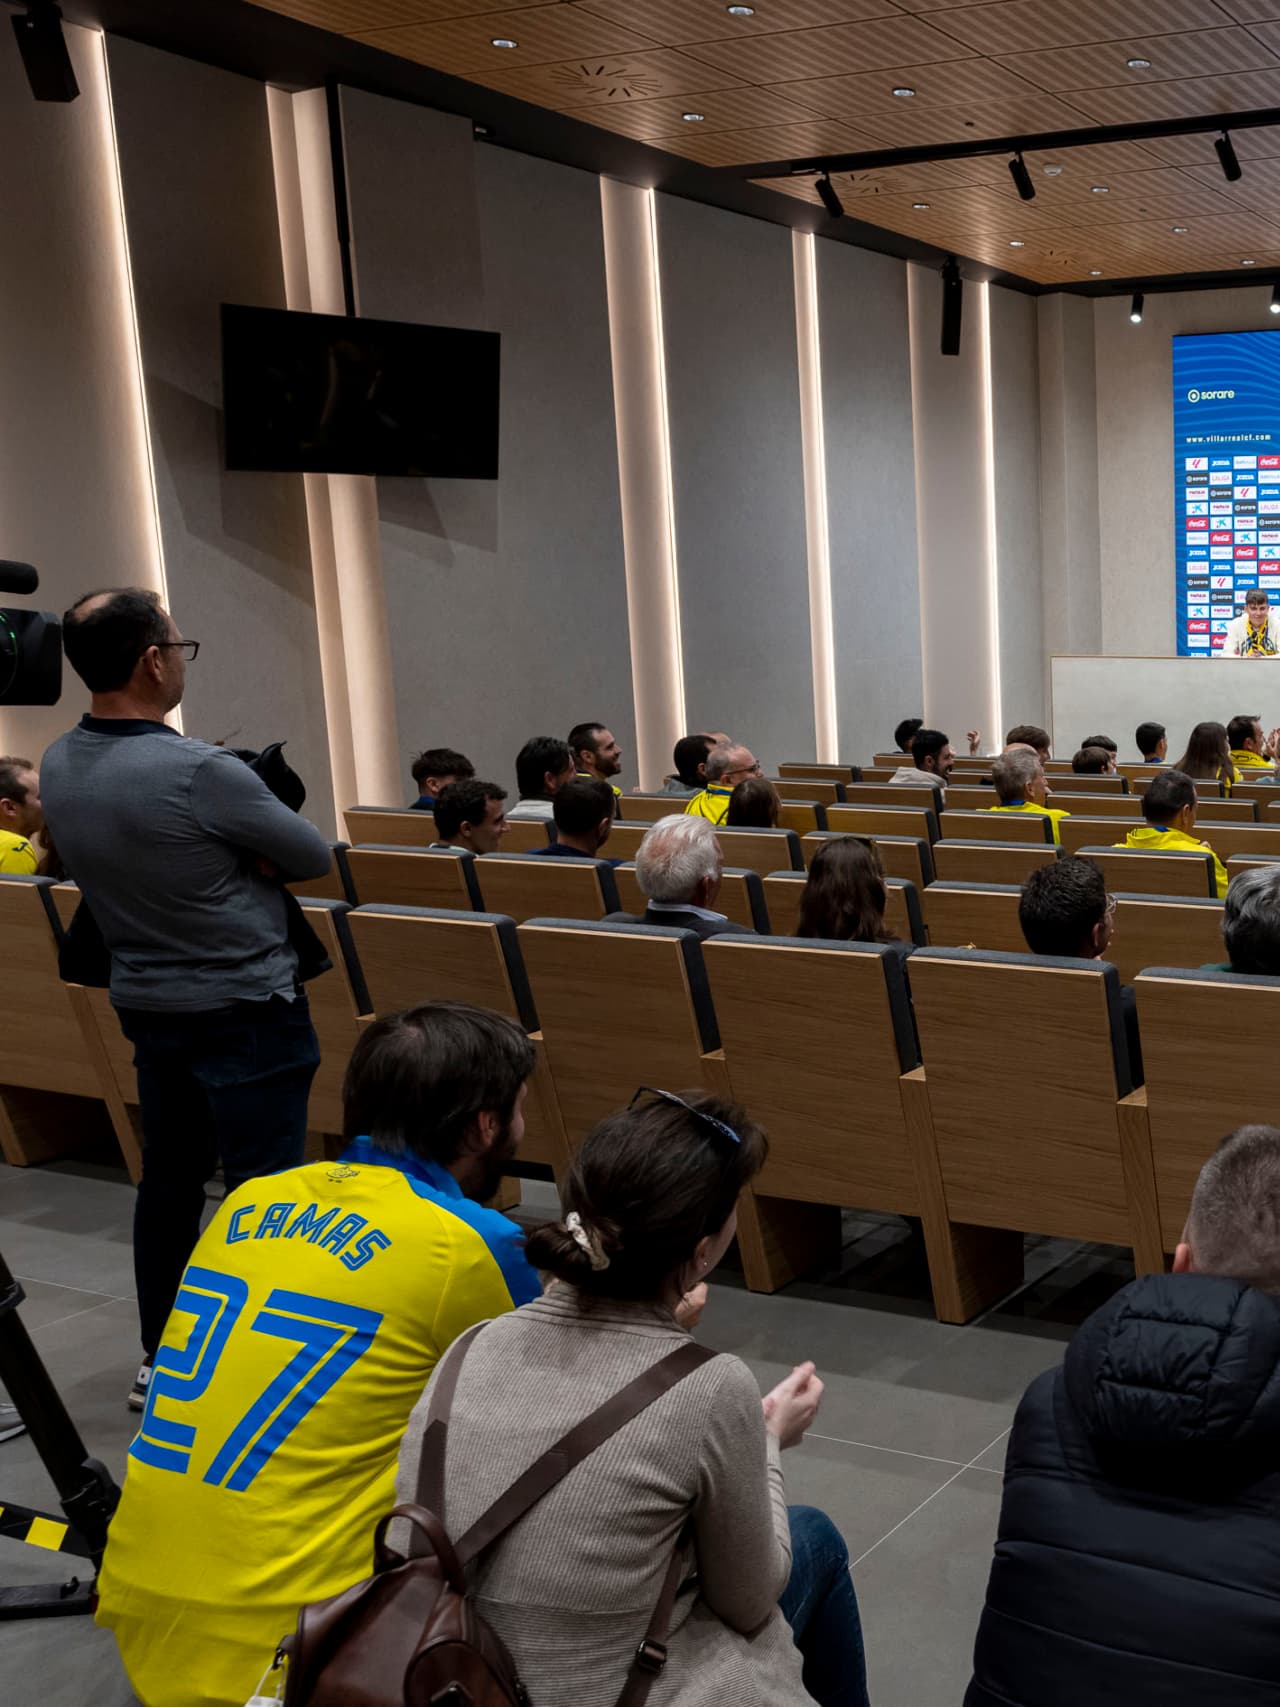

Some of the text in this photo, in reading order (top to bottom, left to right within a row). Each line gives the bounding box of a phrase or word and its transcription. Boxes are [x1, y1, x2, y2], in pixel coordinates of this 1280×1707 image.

[1201, 390, 1235, 400] sorare
[1186, 434, 1271, 443] www.villarrealcf.com
[226, 1203, 392, 1271] CAMAS
[128, 1265, 384, 1492] 27
